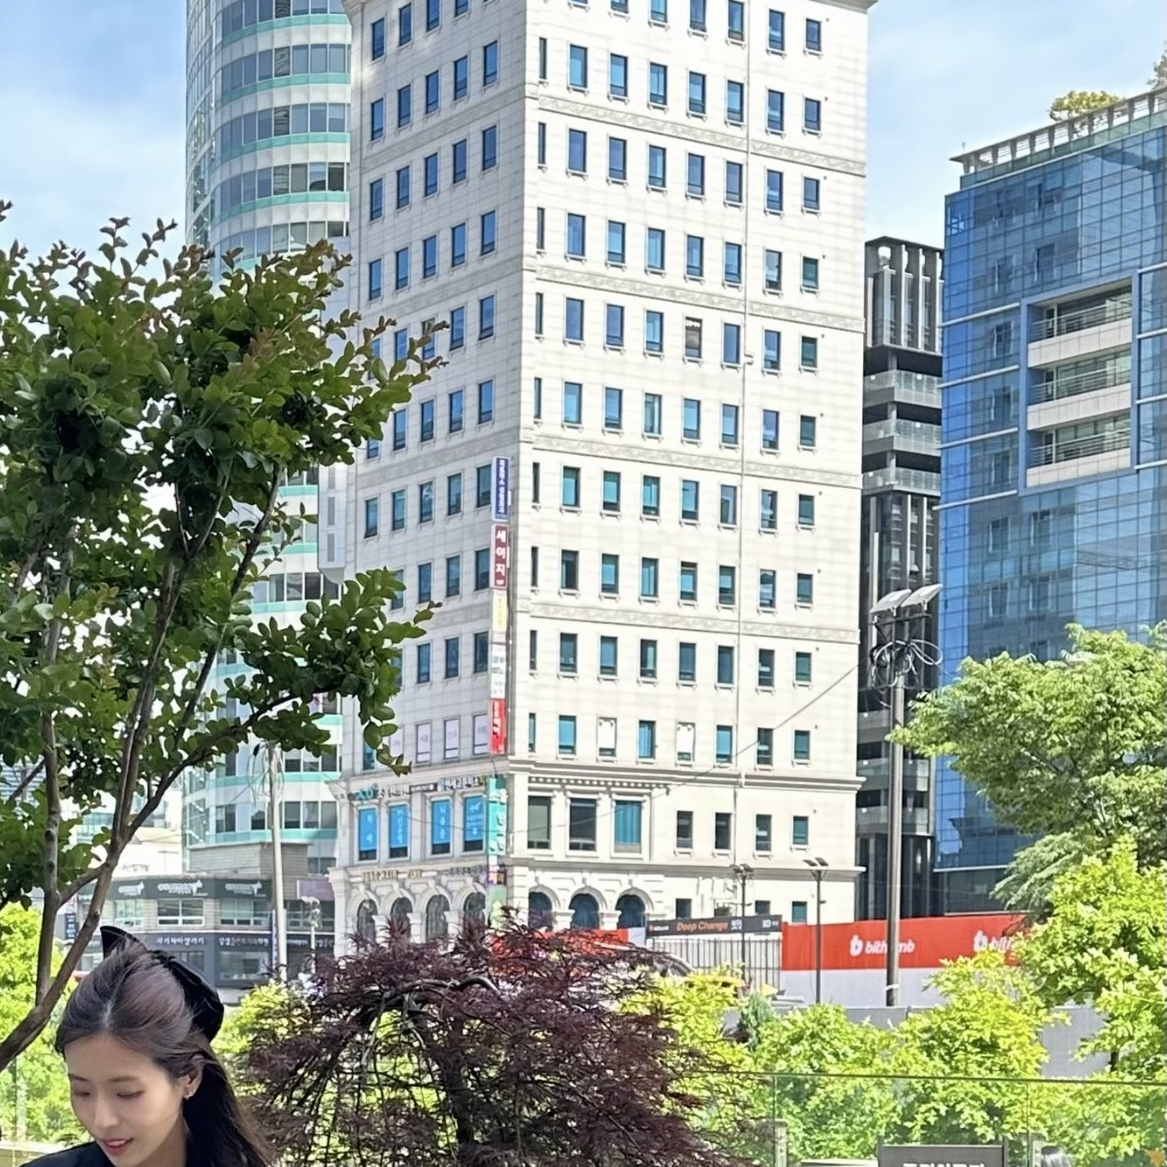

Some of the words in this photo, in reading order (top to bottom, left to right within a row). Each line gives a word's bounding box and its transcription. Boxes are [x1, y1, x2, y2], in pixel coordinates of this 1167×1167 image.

[676, 922, 697, 932] Deep
[698, 921, 729, 931] Change
[865, 939, 915, 954] bithmb
